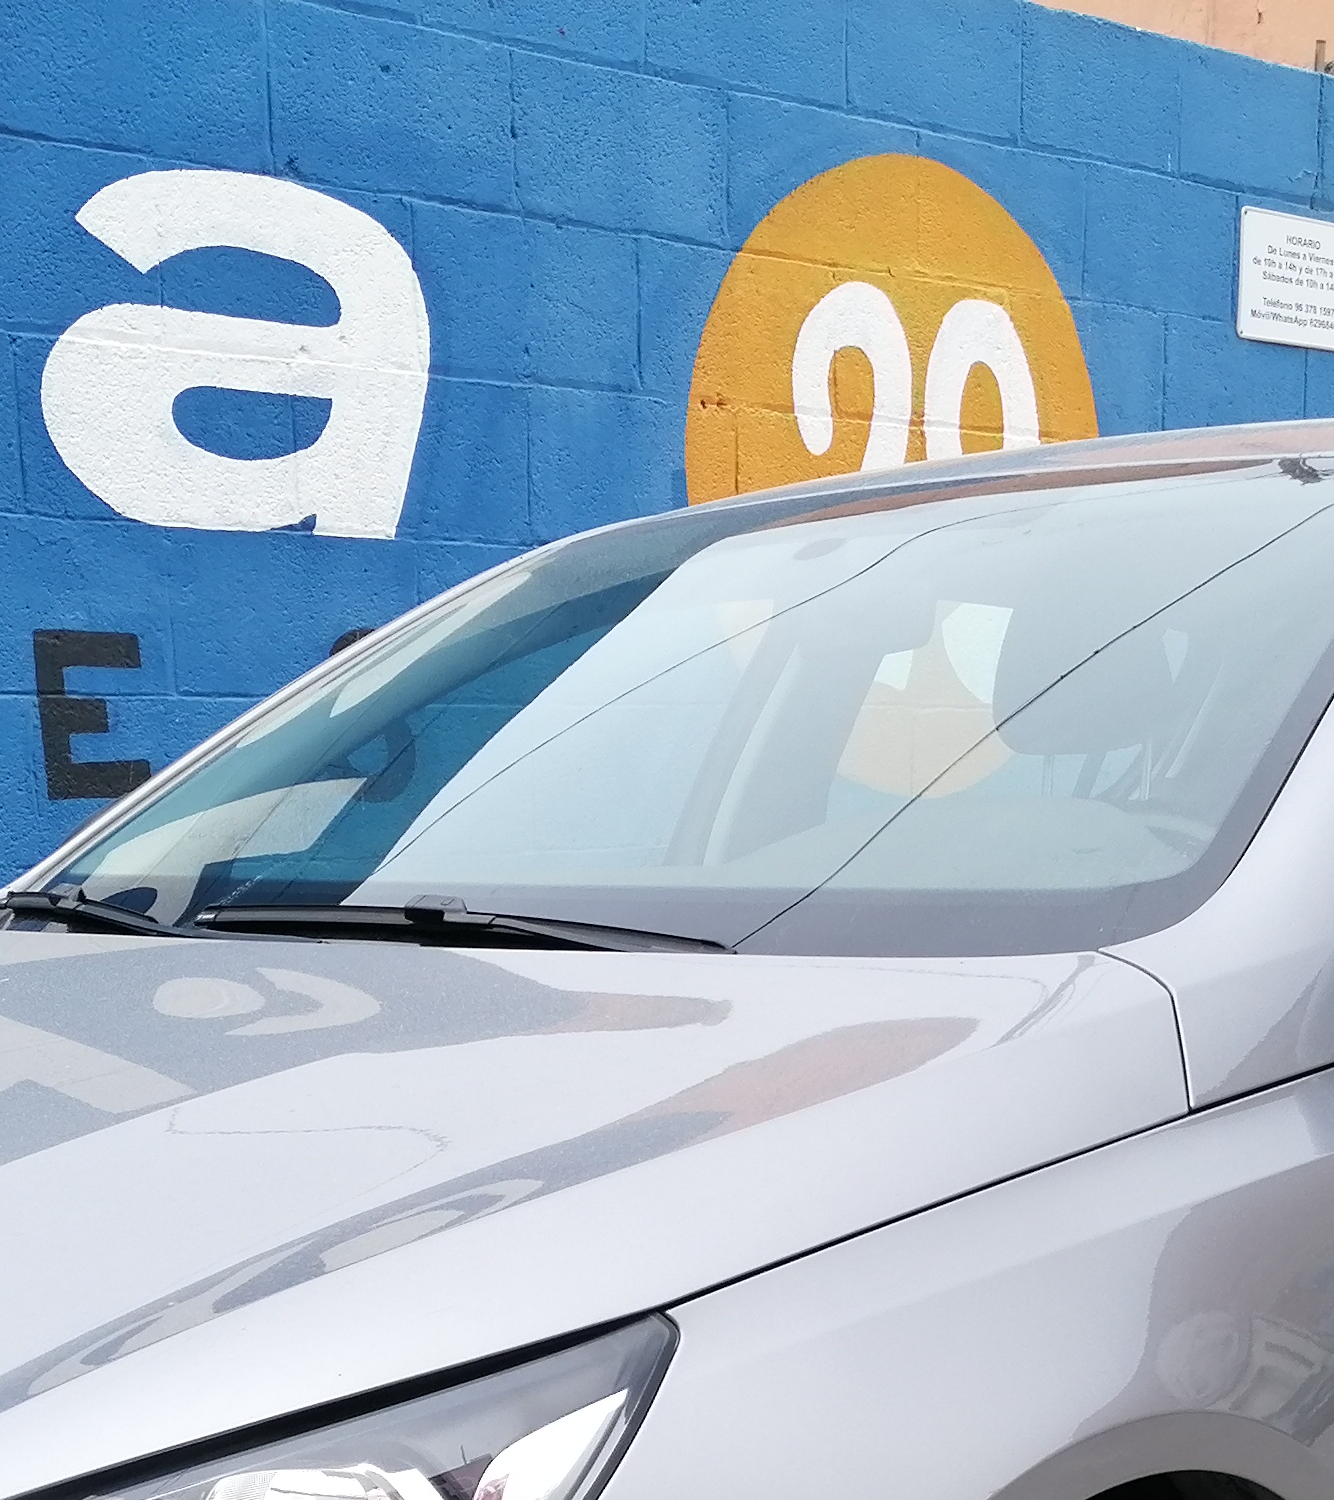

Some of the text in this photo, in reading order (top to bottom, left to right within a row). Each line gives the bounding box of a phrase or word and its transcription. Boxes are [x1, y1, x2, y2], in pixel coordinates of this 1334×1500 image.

[1286, 235, 1322, 250] HORARIO
[1267, 244, 1334, 266] De Lunes a Viernes
[1252, 255, 1261, 266] de
[1298, 266, 1303, 275] y
[1304, 265, 1313, 275] de
[1315, 267, 1328, 278] 17h
[1329, 271, 1334, 279] a
[1295, 277, 1304, 287] de
[1319, 282, 1324, 290] a
